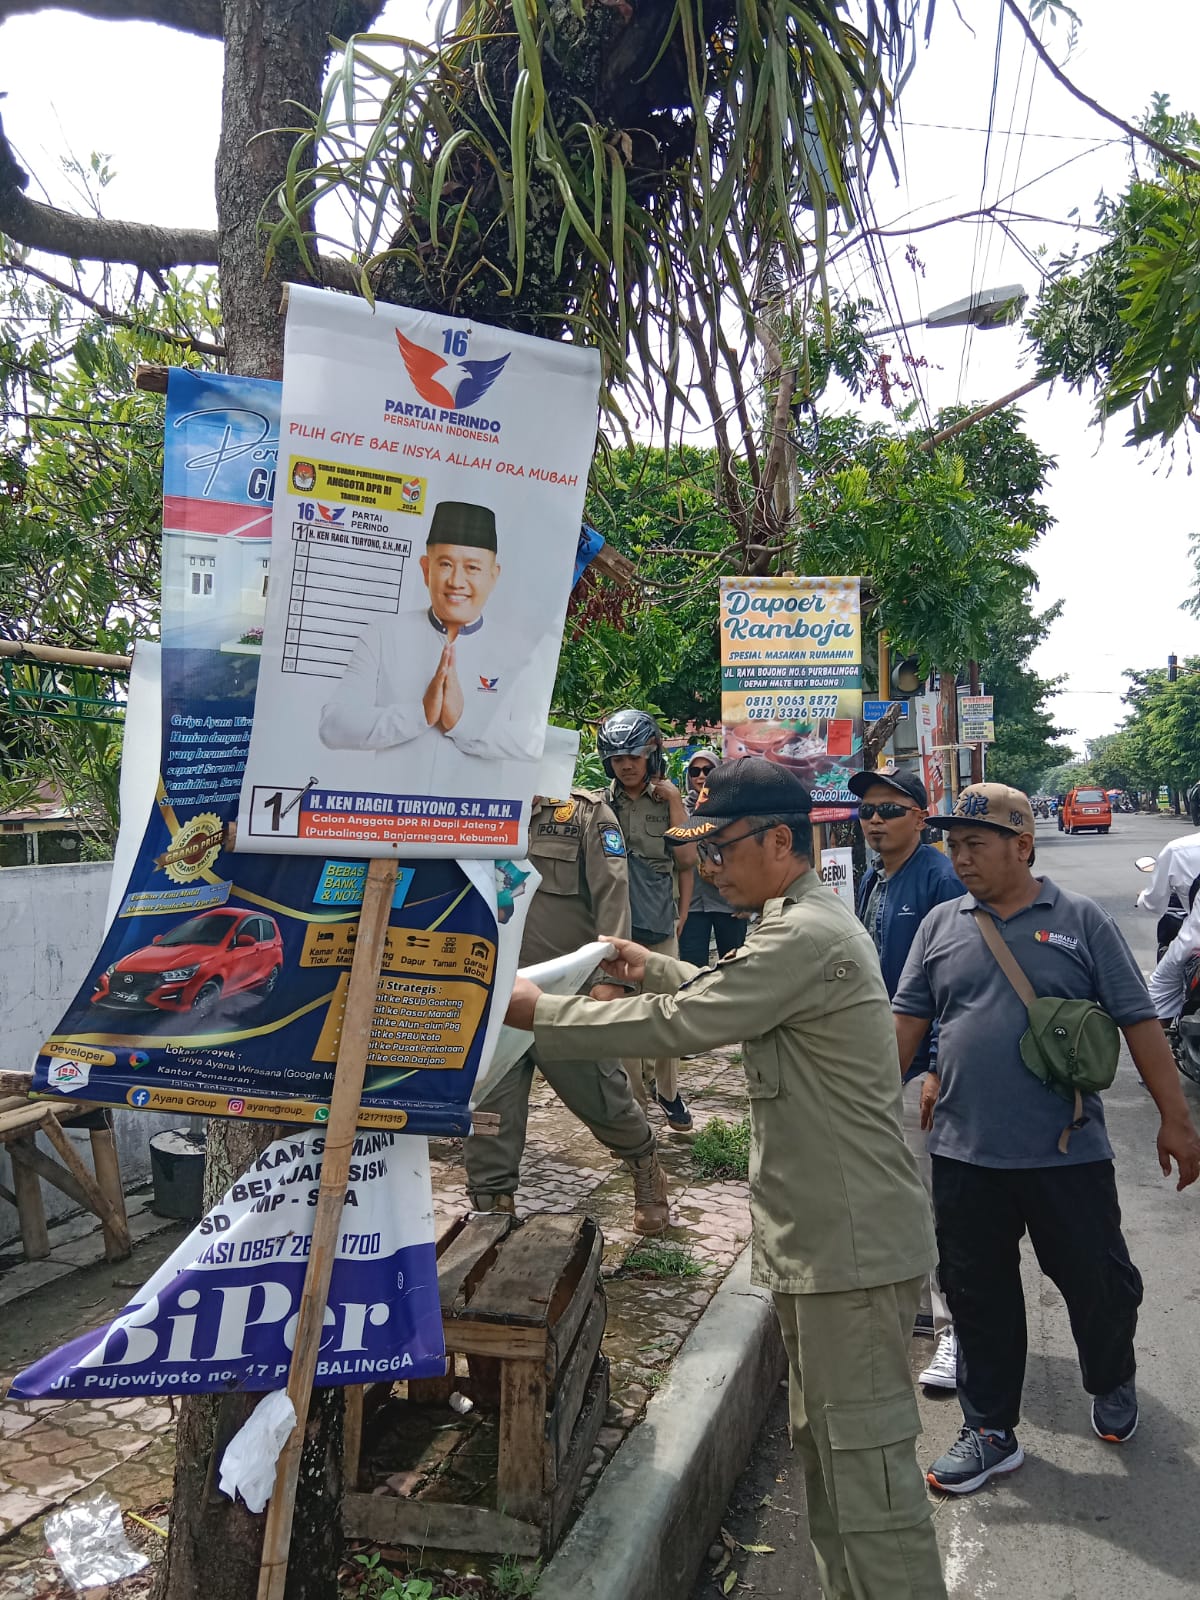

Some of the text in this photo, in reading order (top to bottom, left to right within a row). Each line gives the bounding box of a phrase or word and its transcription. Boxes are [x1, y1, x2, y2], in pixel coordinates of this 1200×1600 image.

[441, 328, 468, 357] 16
[384, 399, 501, 433] PARTAI PERINDO
[383, 413, 500, 444] PERSATUAN INDONESIA
[289, 422, 579, 487] PILIH GIYE BAE INSYA ALLAH ORA MUBAH
[327, 476, 392, 496] ANGGOTA DPR RI
[340, 492, 377, 505] TAHUN 2024
[297, 502, 315, 521] 16
[352, 510, 383, 523] PARTAI
[351, 521, 389, 534] PERINDO
[309, 530, 317, 539] H.
[317, 530, 330, 542] KEN
[331, 532, 349, 544] RAGIL
[351, 536, 381, 550] TURYONO,
[726, 591, 826, 618] Dapoer
[723, 617, 855, 647] Kamboja
[728, 650, 854, 661] SPESIAL MASAKAN RUMAHAN
[736, 667, 755, 678] RAYA
[757, 667, 787, 678] BOJONG
[807, 666, 859, 677] PURBALINGGA
[744, 678, 839, 688] DEPAN HALTE BRT BOJONG
[745, 695, 838, 707] 0813 9063 8872
[748, 707, 837, 719] 0821 3326 5711
[263, 791, 283, 832] 1
[309, 795, 323, 809] H.
[326, 795, 353, 811] KEN
[355, 796, 394, 814] RAGIL
[397, 799, 458, 817] TURYONO,
[488, 803, 513, 818] M.H.
[312, 813, 505, 833] Calon Anggota DPR RI Dapil Jateng 7
[540, 825, 578, 835] POL PP
[305, 827, 509, 843] (Purbalingga, Banjarnegara, Kebumen)
[165, 832, 223, 863] GRAND PRIZE
[326, 865, 365, 878] BEBAS
[323, 877, 357, 890] BANK,
[309, 947, 334, 956] Kamar
[310, 956, 329, 964] Tidur
[400, 955, 426, 969] Dapur
[432, 959, 457, 968] Taman
[463, 958, 489, 972] Garasi
[463, 966, 486, 978] Mobil
[386, 981, 436, 996] Strategis
[389, 994, 464, 1009] ke RSUD Goeteng
[387, 1006, 399, 1015] ke
[400, 1008, 427, 1018] Pasar
[385, 1018, 461, 1032] ke Alun-alun Pbg
[383, 1030, 441, 1042] ke SPBU Kota
[49, 1043, 105, 1064] Developer
[380, 1042, 464, 1054] ke Pusat Perkotaan
[377, 1054, 388, 1063] ke
[389, 1055, 410, 1065] GOR
[157, 1066, 250, 1085] Kantor Pemasaran
[204, 1058, 235, 1072] Ayana
[238, 1065, 282, 1078] Wirasana
[283, 1067, 321, 1081] (Google
[152, 1093, 217, 1110] Ayana Group
[199, 1213, 231, 1236] SD
[307, 1188, 359, 1207] SA
[239, 1232, 381, 1262] 0857 1700
[51, 1374, 76, 1390] Jl.
[84, 1370, 201, 1389] Pujowiyoto
[208, 1367, 238, 1384] no.
[274, 1352, 414, 1378] PBALINGGA
